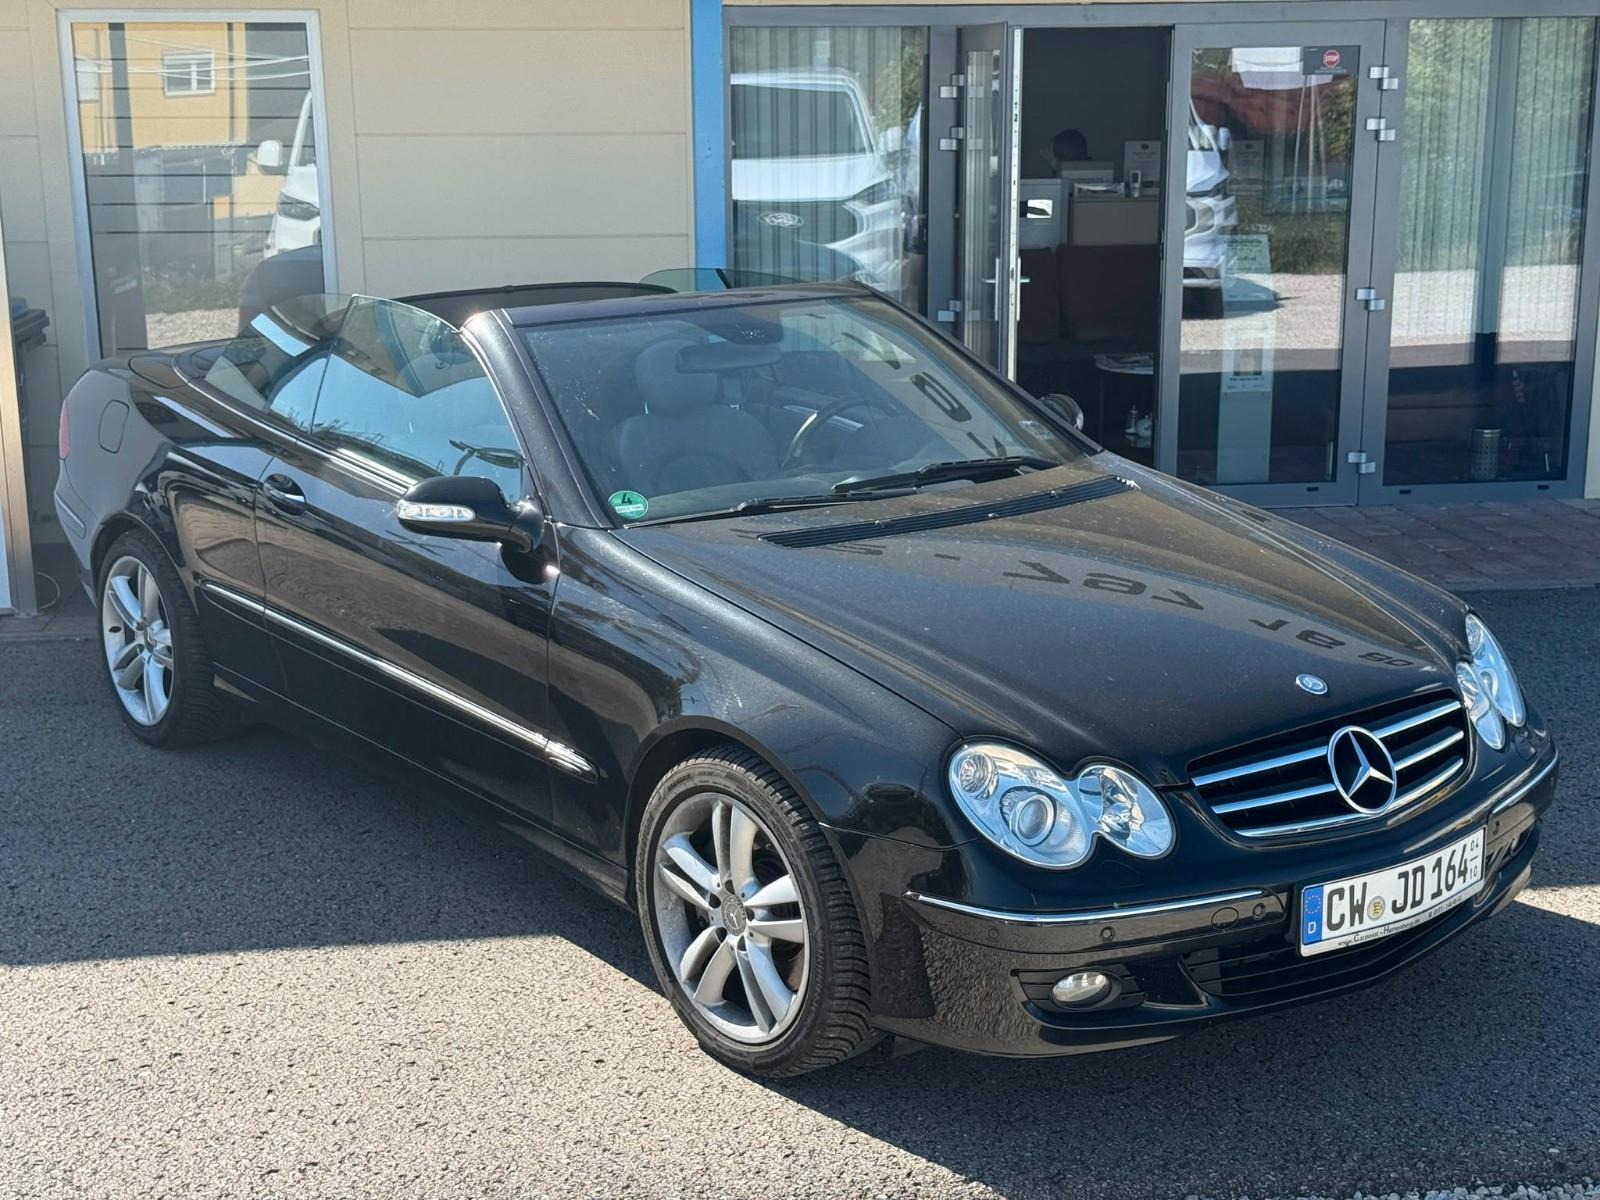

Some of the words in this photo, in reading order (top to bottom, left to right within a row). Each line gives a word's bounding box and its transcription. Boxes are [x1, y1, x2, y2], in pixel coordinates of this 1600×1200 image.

[621, 493, 632, 504] 4
[1470, 836, 1479, 851] 04
[1470, 865, 1478, 880] 10
[1307, 921, 1317, 935] D
[1326, 881, 1368, 932] CW
[1391, 864, 1426, 915] JD
[1431, 843, 1469, 901] 164
